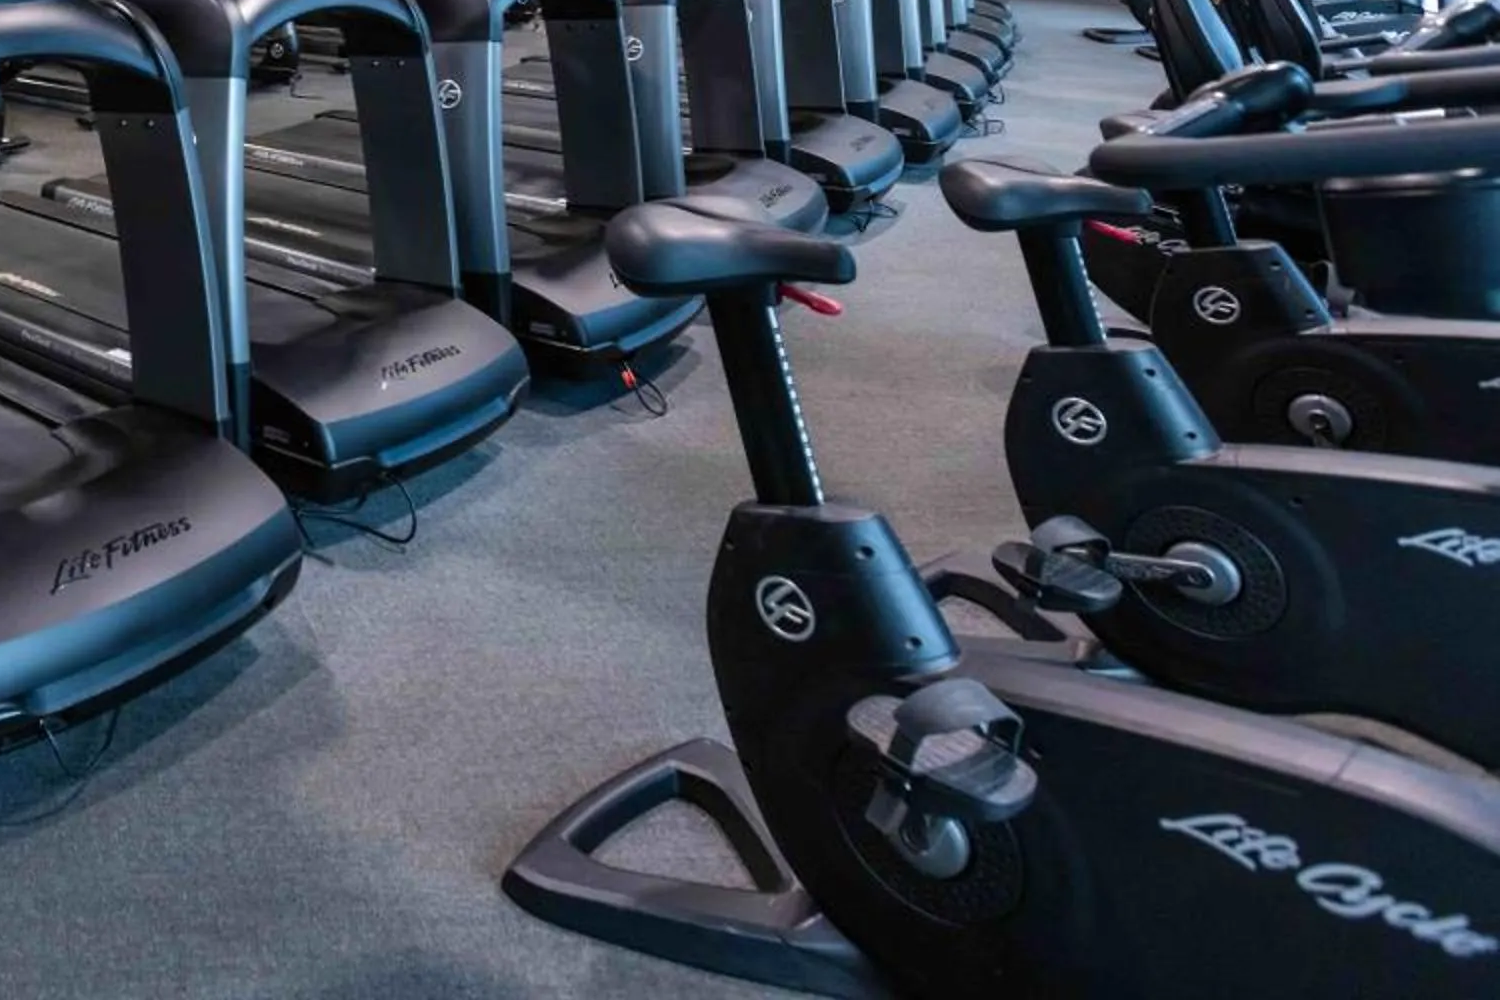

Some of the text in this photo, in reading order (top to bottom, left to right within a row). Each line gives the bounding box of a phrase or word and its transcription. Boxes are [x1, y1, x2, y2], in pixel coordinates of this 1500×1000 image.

[50, 516, 192, 596] Life Fitness
[1158, 813, 1499, 957] Life Cycle
